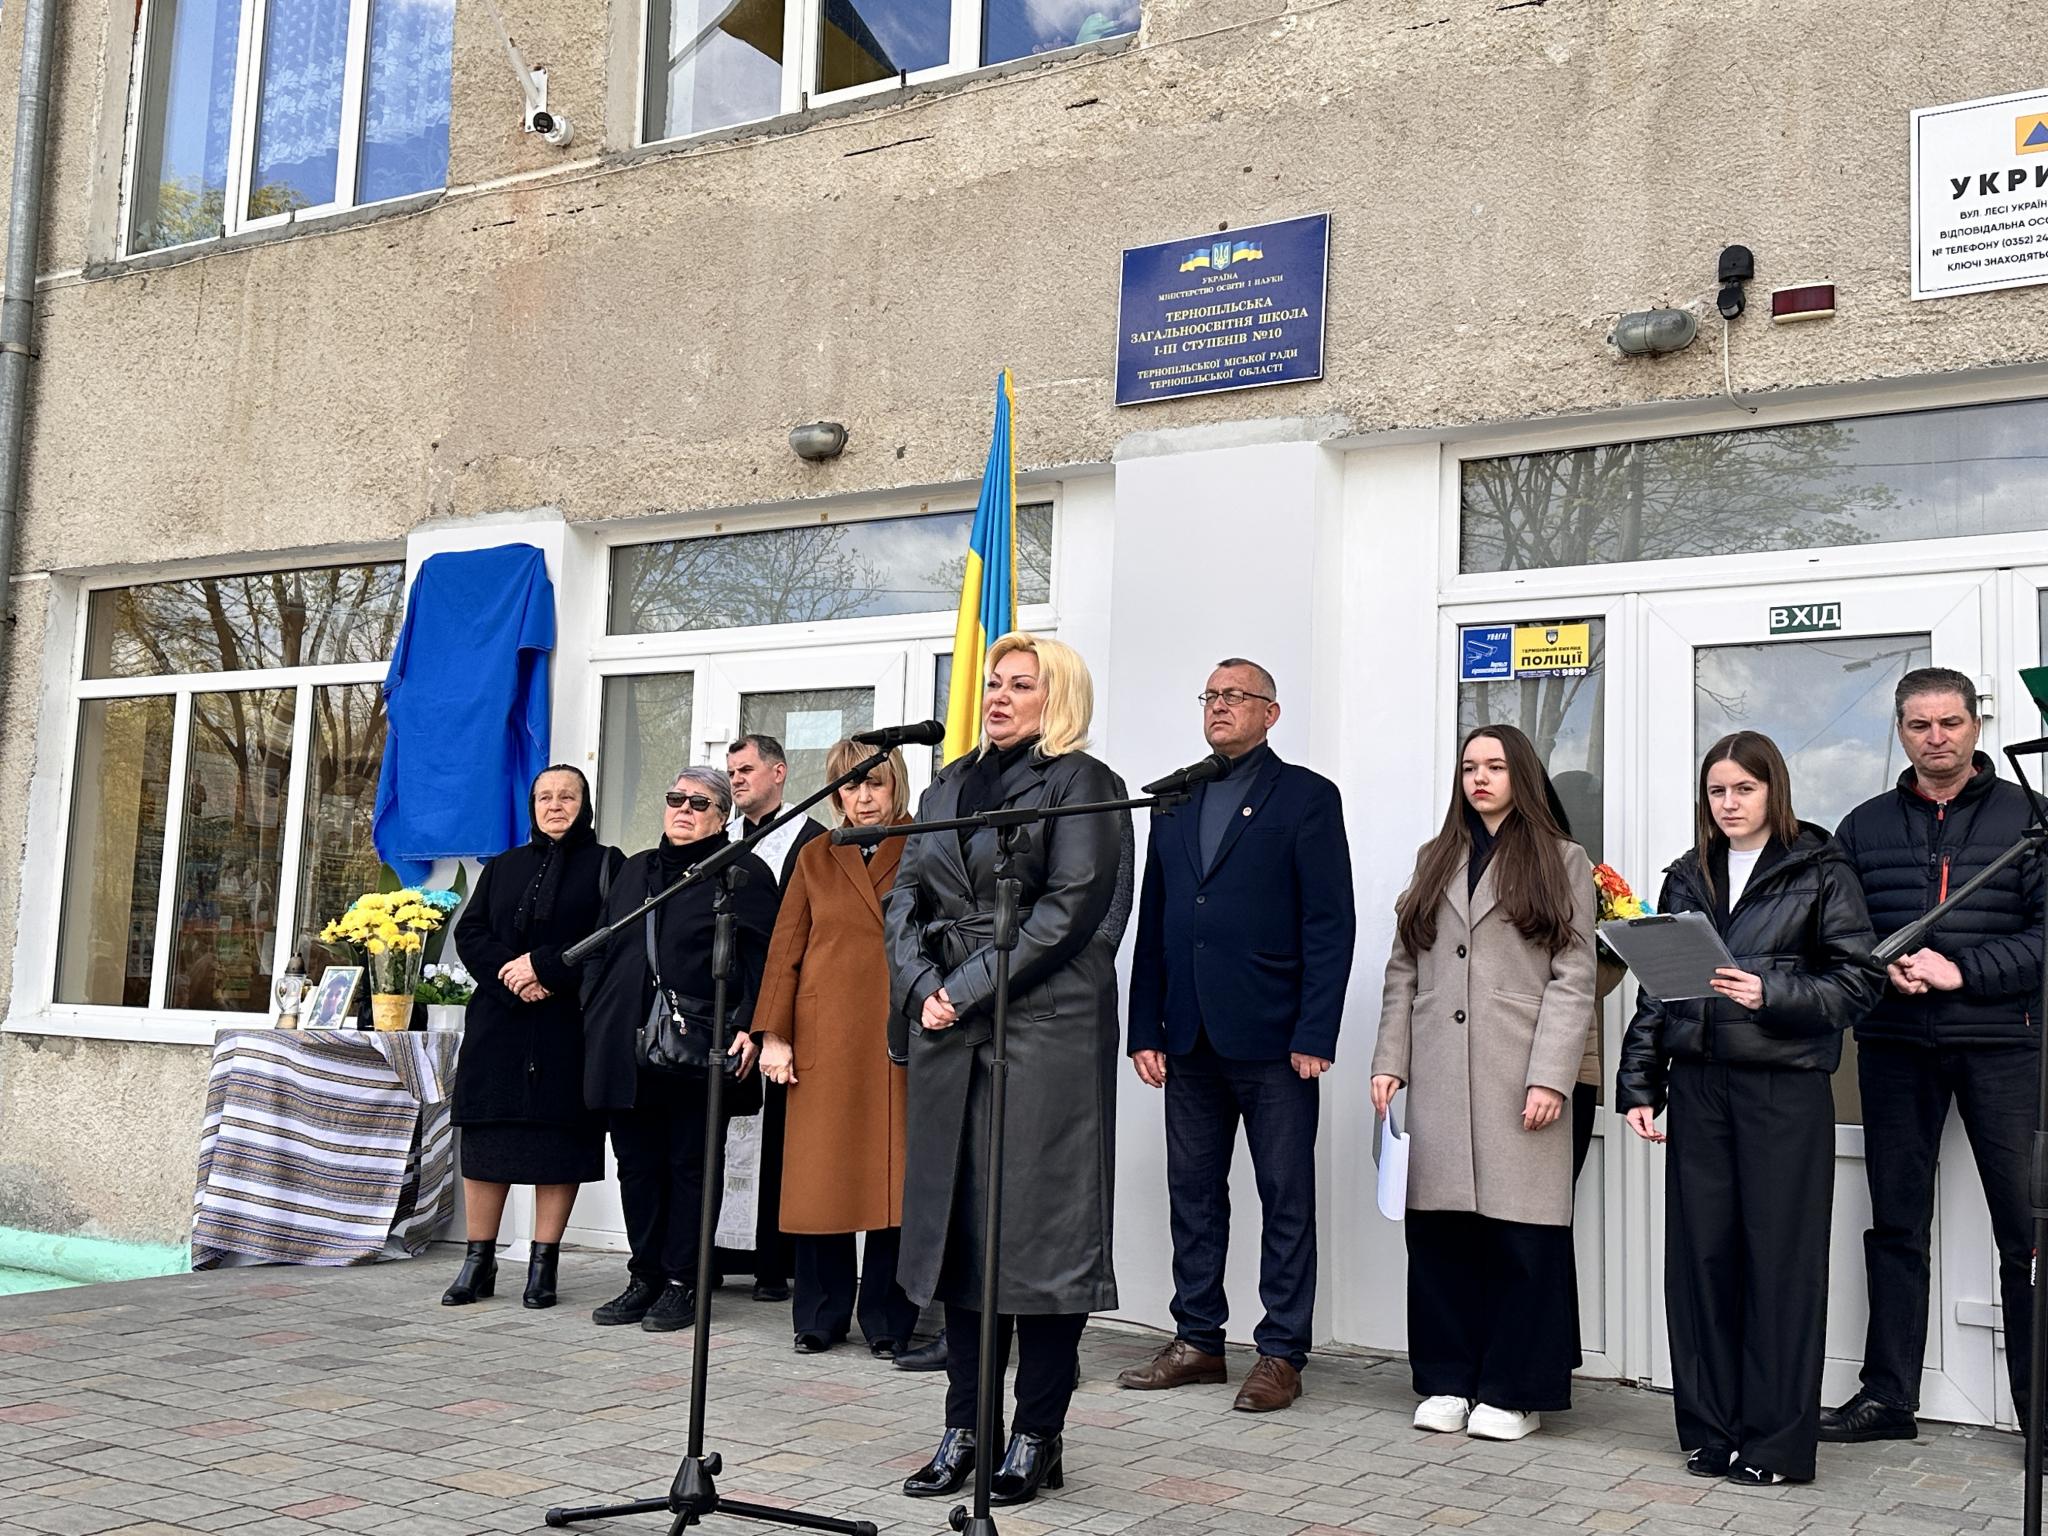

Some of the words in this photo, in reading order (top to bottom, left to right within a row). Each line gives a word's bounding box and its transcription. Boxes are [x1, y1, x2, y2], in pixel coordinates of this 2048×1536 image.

[1960, 209, 1981, 220] ВУЛ.
[1984, 205, 2009, 217] ЛЕСІ
[1940, 220, 2025, 240] ВІДПОВІДАЛЬНА
[1945, 240, 1999, 256] ТЕЛЕФОНУ
[2002, 235, 2033, 249] (0352)
[1947, 260, 1982, 272] КЛЮЧІ
[1158, 286, 1214, 301] МІНІСТЕРСТВО
[1216, 281, 1245, 292] ОСВІТИ
[1254, 274, 1284, 286] НАУКИ
[1202, 273, 1238, 285] УКРАЇНА
[1165, 297, 1273, 322] ТЕРНОПІЛЬСЬКА
[1130, 315, 1253, 344] ЗАГАЛЬНООСВІТНЯ
[1258, 307, 1308, 325] ШКОЛА
[1182, 332, 1247, 352] СТУПЕНІВ
[1252, 327, 1282, 342] №10
[1137, 359, 1220, 379] ТЕРНОПІЛЬСЬКОЇ
[1224, 352, 1266, 367] МІСЬКОЇ
[1270, 348, 1298, 361] РАДИ
[1149, 369, 1233, 389] ТЕРНОПІЛЬСЬКОЇ
[1239, 363, 1283, 377] ОБЛАСТІ
[1770, 604, 1841, 629] ВХІД
[1521, 650, 1583, 667] ПОЛІЦІЇ
[1561, 667, 1587, 677] 9899
